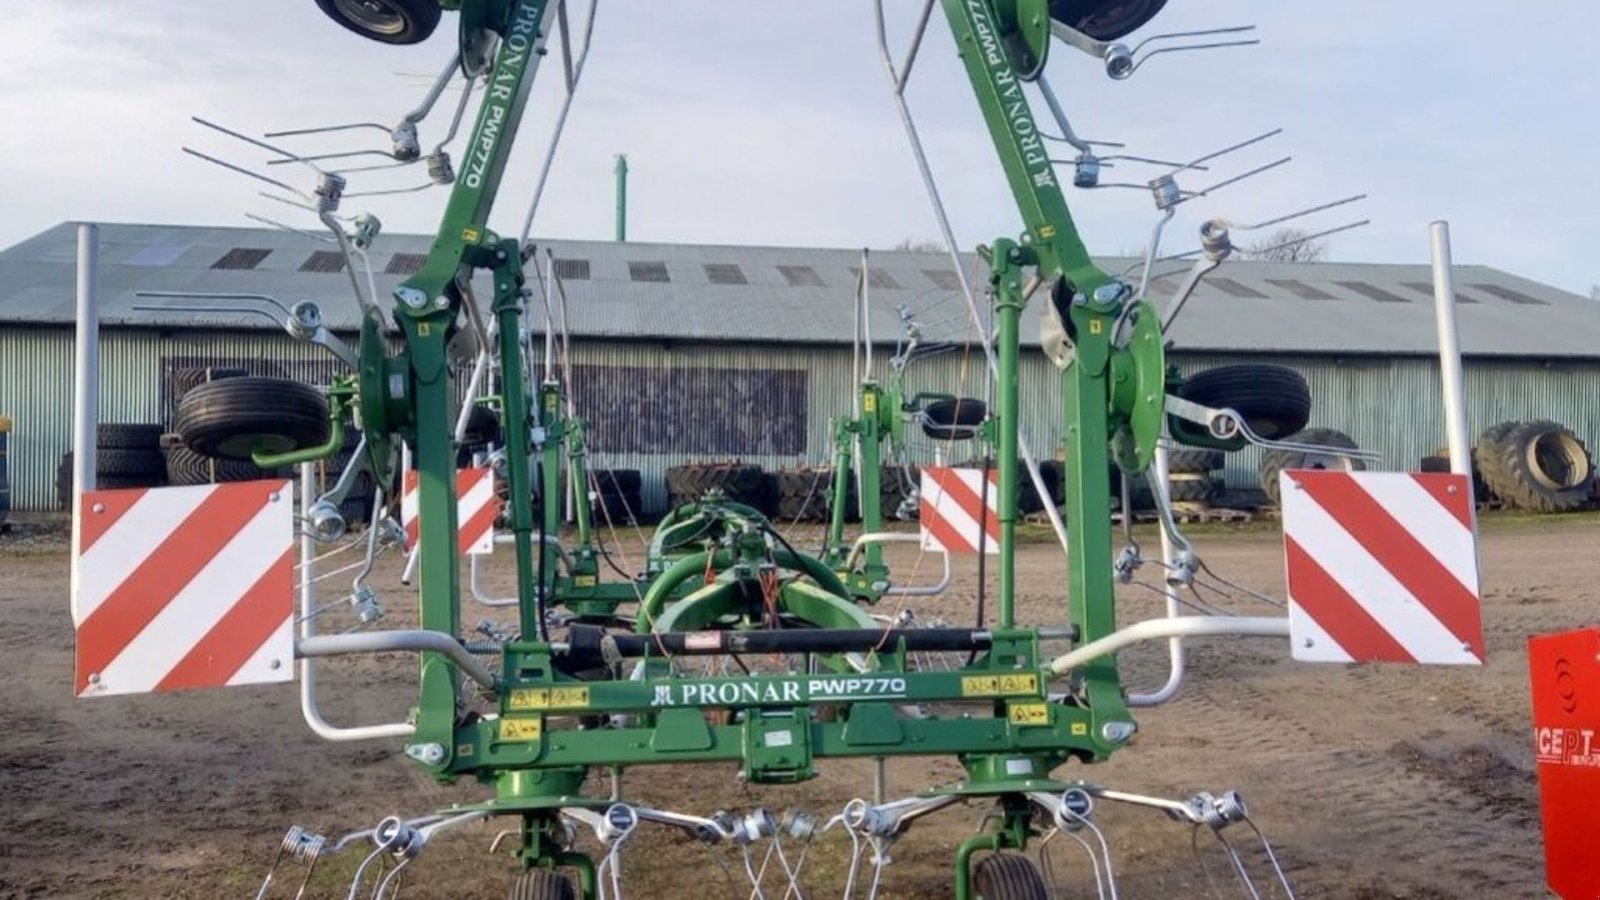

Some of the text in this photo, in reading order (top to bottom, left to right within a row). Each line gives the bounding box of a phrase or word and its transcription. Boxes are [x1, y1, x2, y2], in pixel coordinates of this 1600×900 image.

[466, 5, 538, 188] PRONAR PWP770
[996, 67, 1044, 165] PRONAR
[681, 678, 907, 706] PRONAR PWP770
[1534, 727, 1595, 765] CEPT
